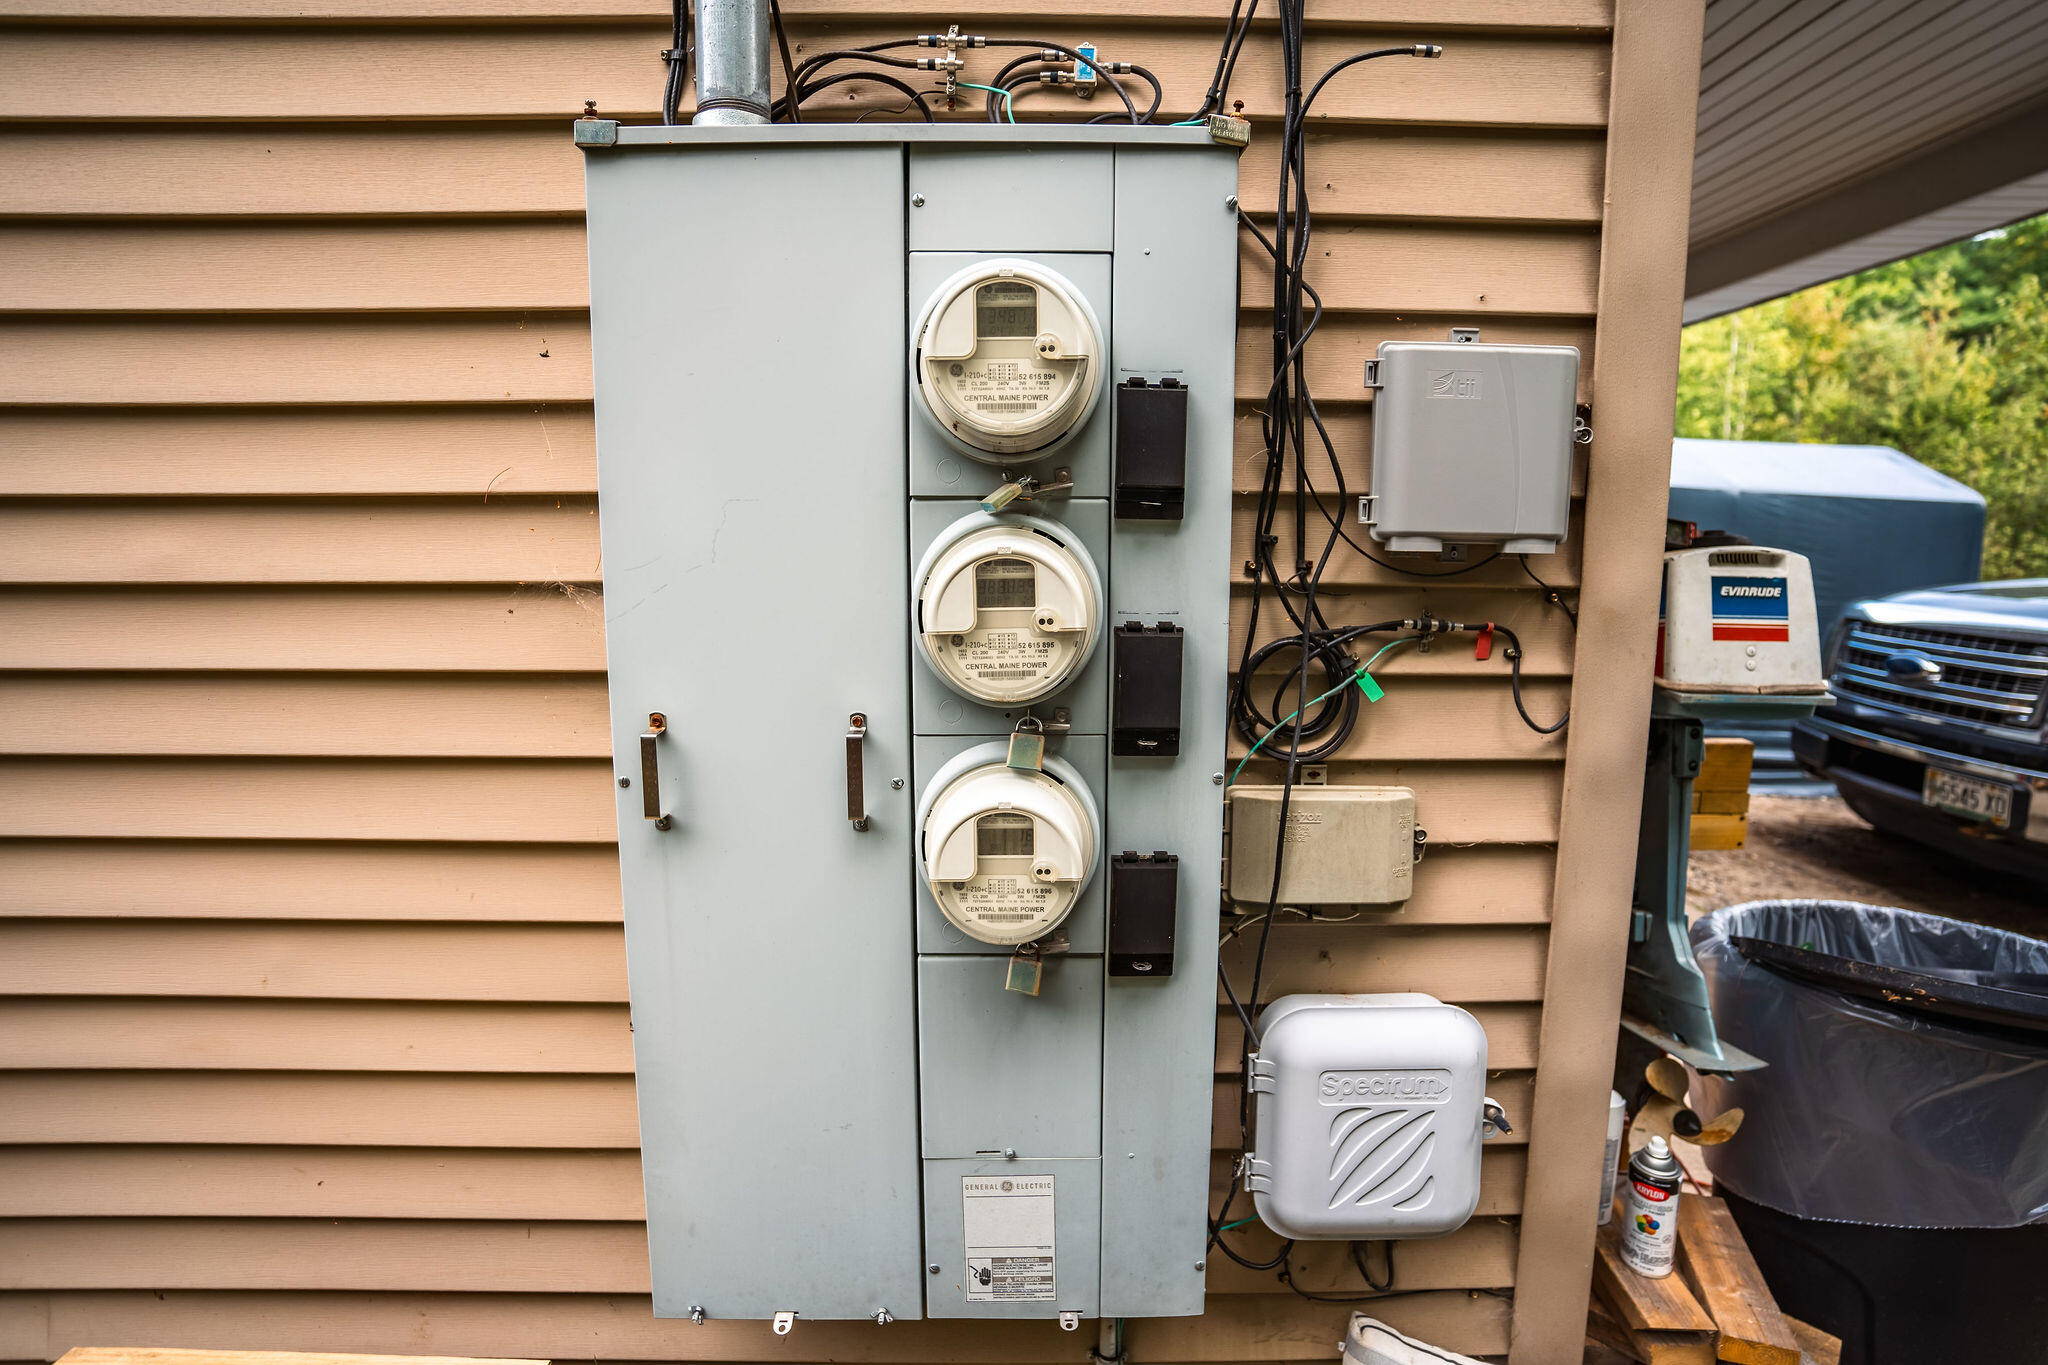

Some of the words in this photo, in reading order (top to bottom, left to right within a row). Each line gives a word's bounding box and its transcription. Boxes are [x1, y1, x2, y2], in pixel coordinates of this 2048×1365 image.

[1720, 586, 1782, 597] EVINRUDE
[1021, 661, 1048, 669] POWER
[1322, 1073, 1440, 1096] Spectrum
[1016, 1182, 1052, 1190] ELECTRIC
[1637, 1183, 1665, 1200] KRYLON
